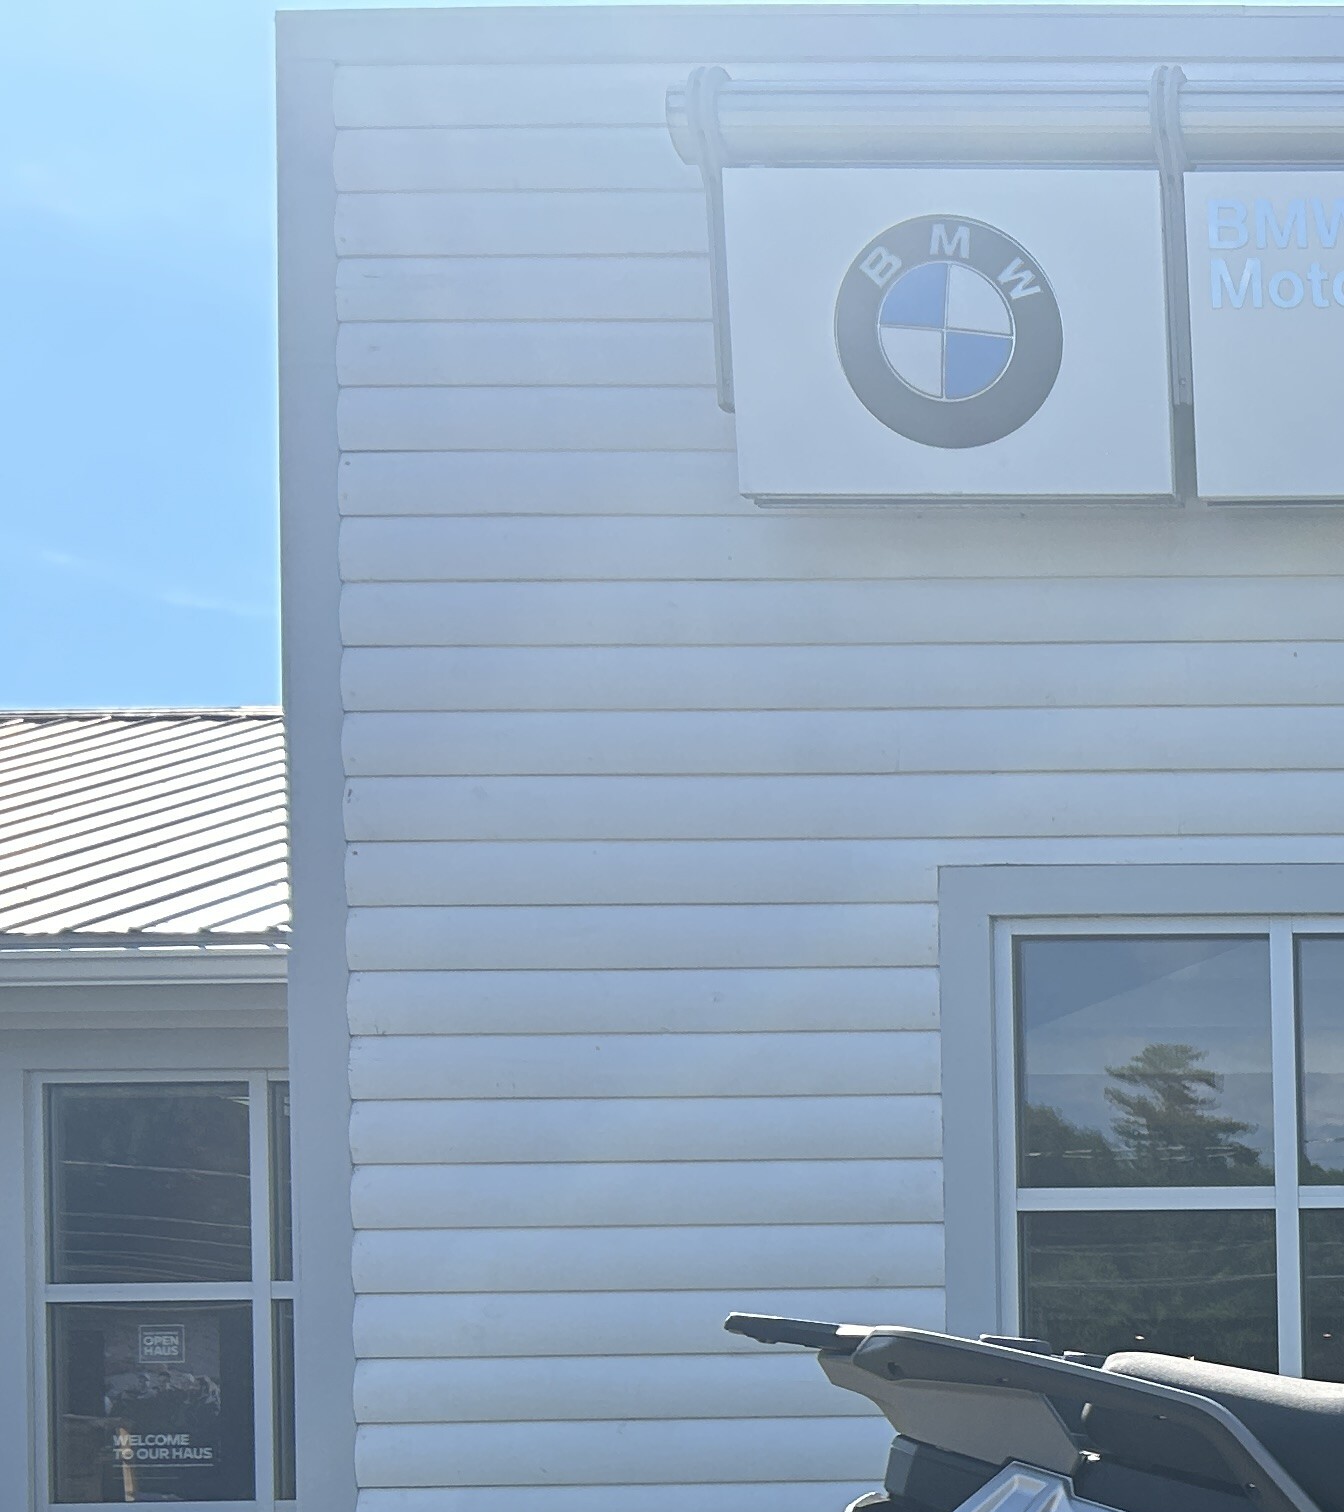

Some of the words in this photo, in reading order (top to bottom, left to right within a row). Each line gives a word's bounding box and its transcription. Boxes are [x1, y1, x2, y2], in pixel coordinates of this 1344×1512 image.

[859, 223, 1043, 300] BMW
[143, 1335, 179, 1346] OPEN
[143, 1346, 179, 1356] HAUS
[112, 1433, 190, 1447] WELCOME
[112, 1448, 134, 1461] TO
[136, 1447, 170, 1460] OUR
[171, 1446, 213, 1460] HAUS
